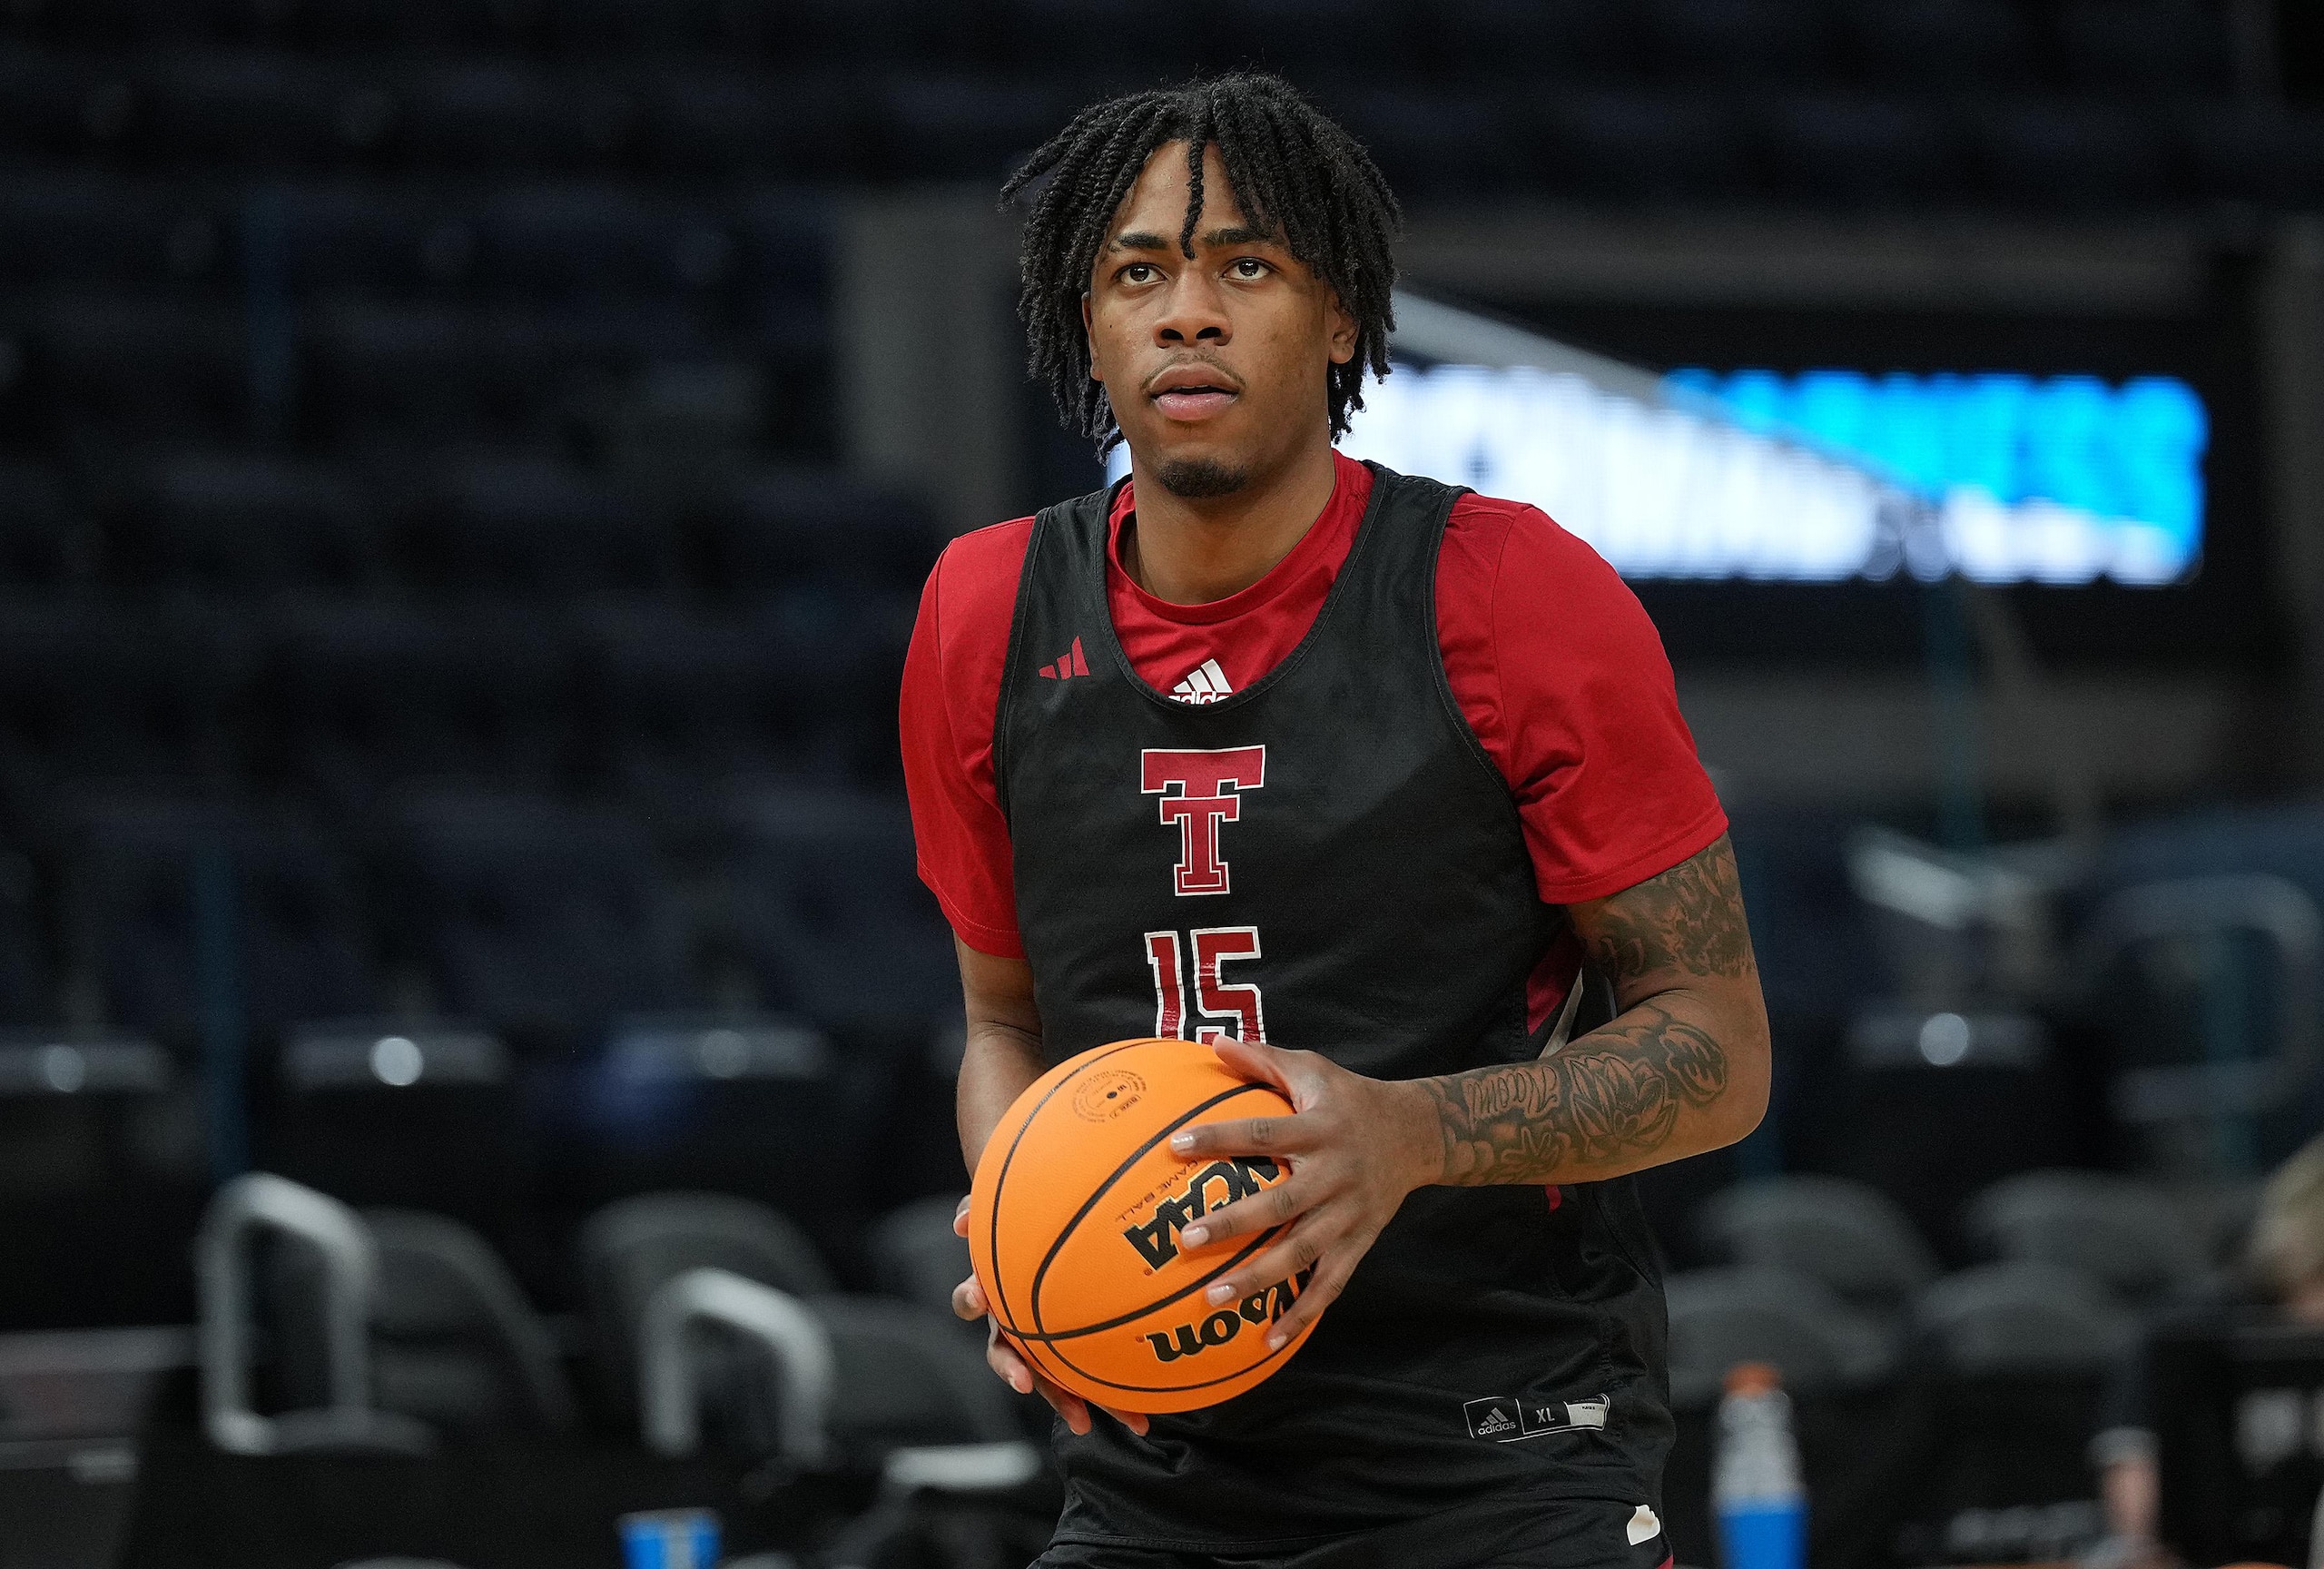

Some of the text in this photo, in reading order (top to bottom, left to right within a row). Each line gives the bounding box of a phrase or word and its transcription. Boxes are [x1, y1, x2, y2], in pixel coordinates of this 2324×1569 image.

[1144, 926, 1266, 1044] 15
[1115, 1159, 1197, 1221] GAME BALL
[1123, 1156, 1281, 1270] NCAA
[1478, 1421, 1516, 1436] adidas
[1536, 1407, 1555, 1424] XL
